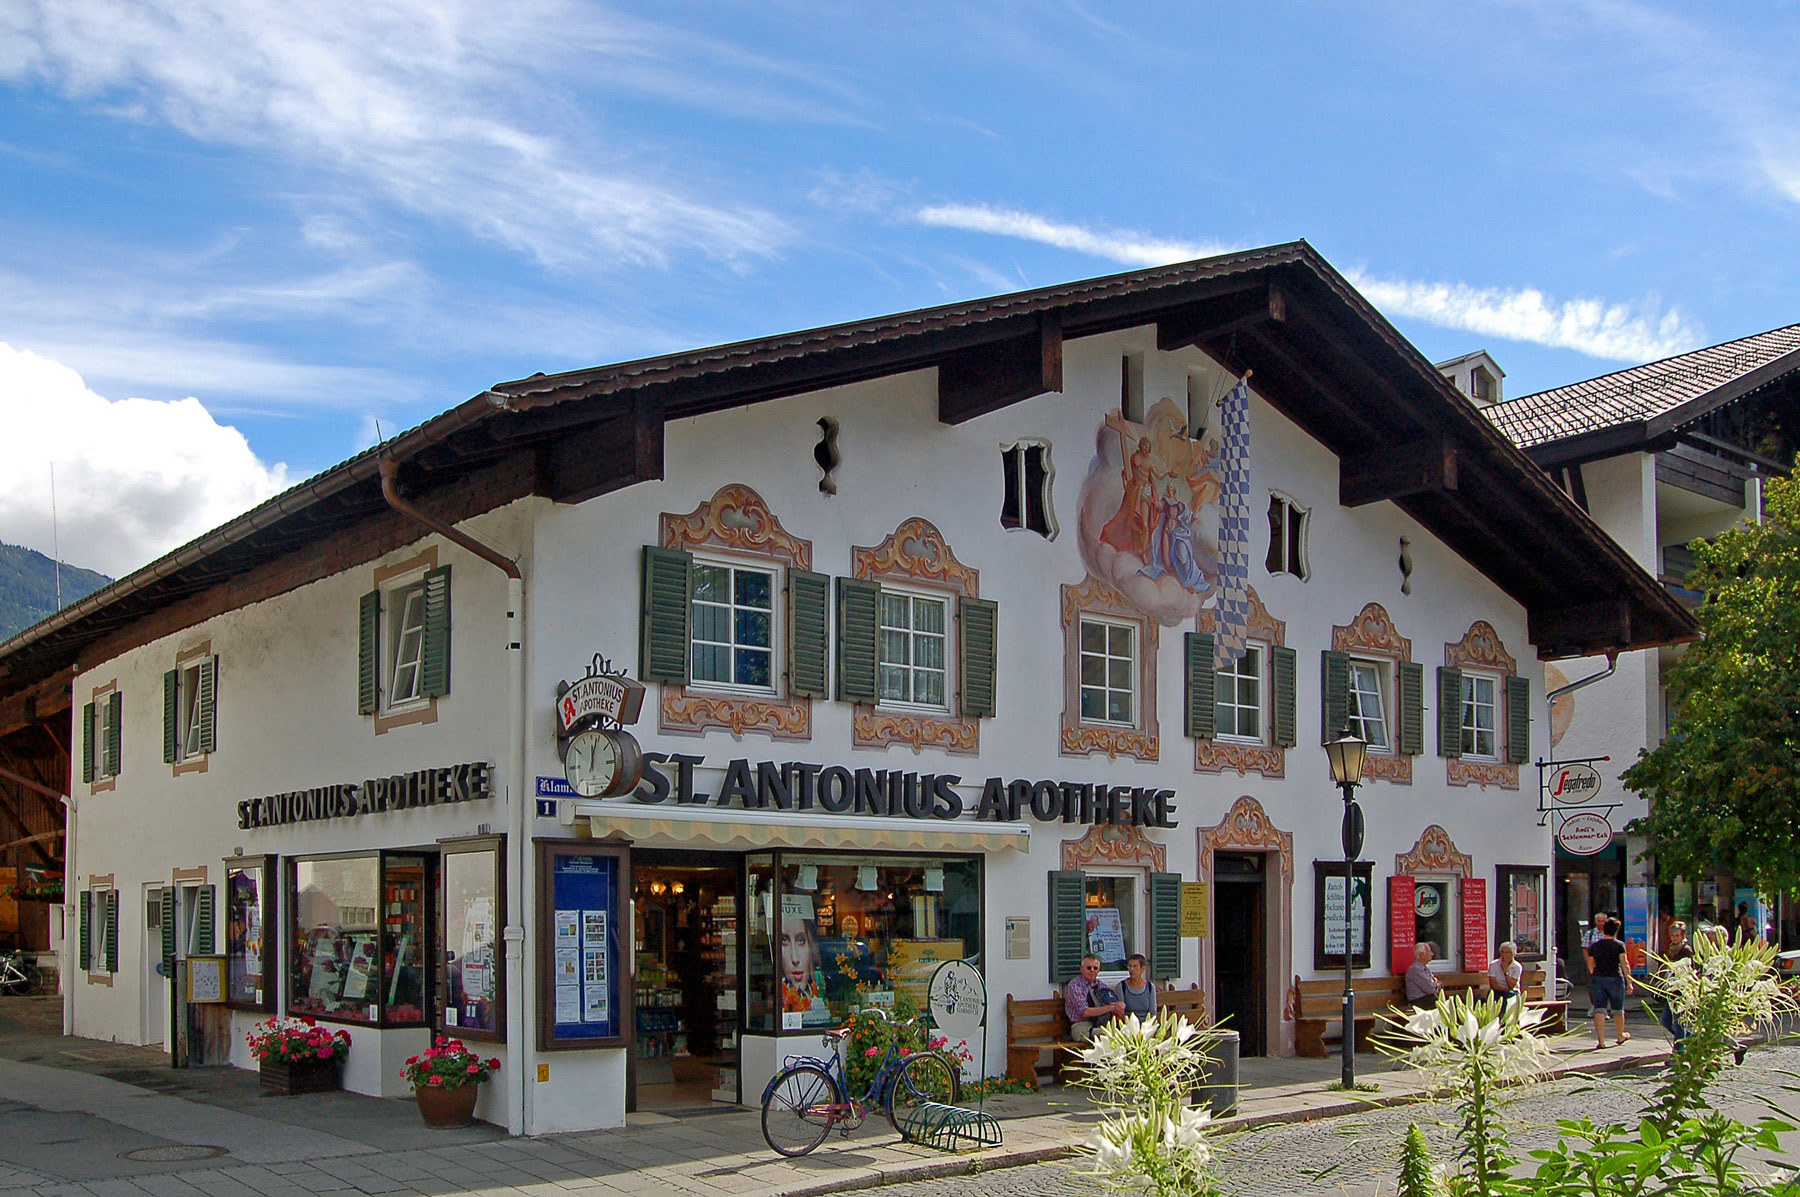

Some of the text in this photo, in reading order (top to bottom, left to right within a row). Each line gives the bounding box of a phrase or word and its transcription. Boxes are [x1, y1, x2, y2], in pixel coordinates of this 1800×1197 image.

[580, 698, 614, 713] APOTHEKE
[357, 762, 491, 815] APOTHEKE
[717, 758, 963, 820] ANTONIUS
[977, 776, 1180, 829] APOTHEKE
[1554, 770, 1596, 795] Segafredo
[543, 802, 551, 815] 1
